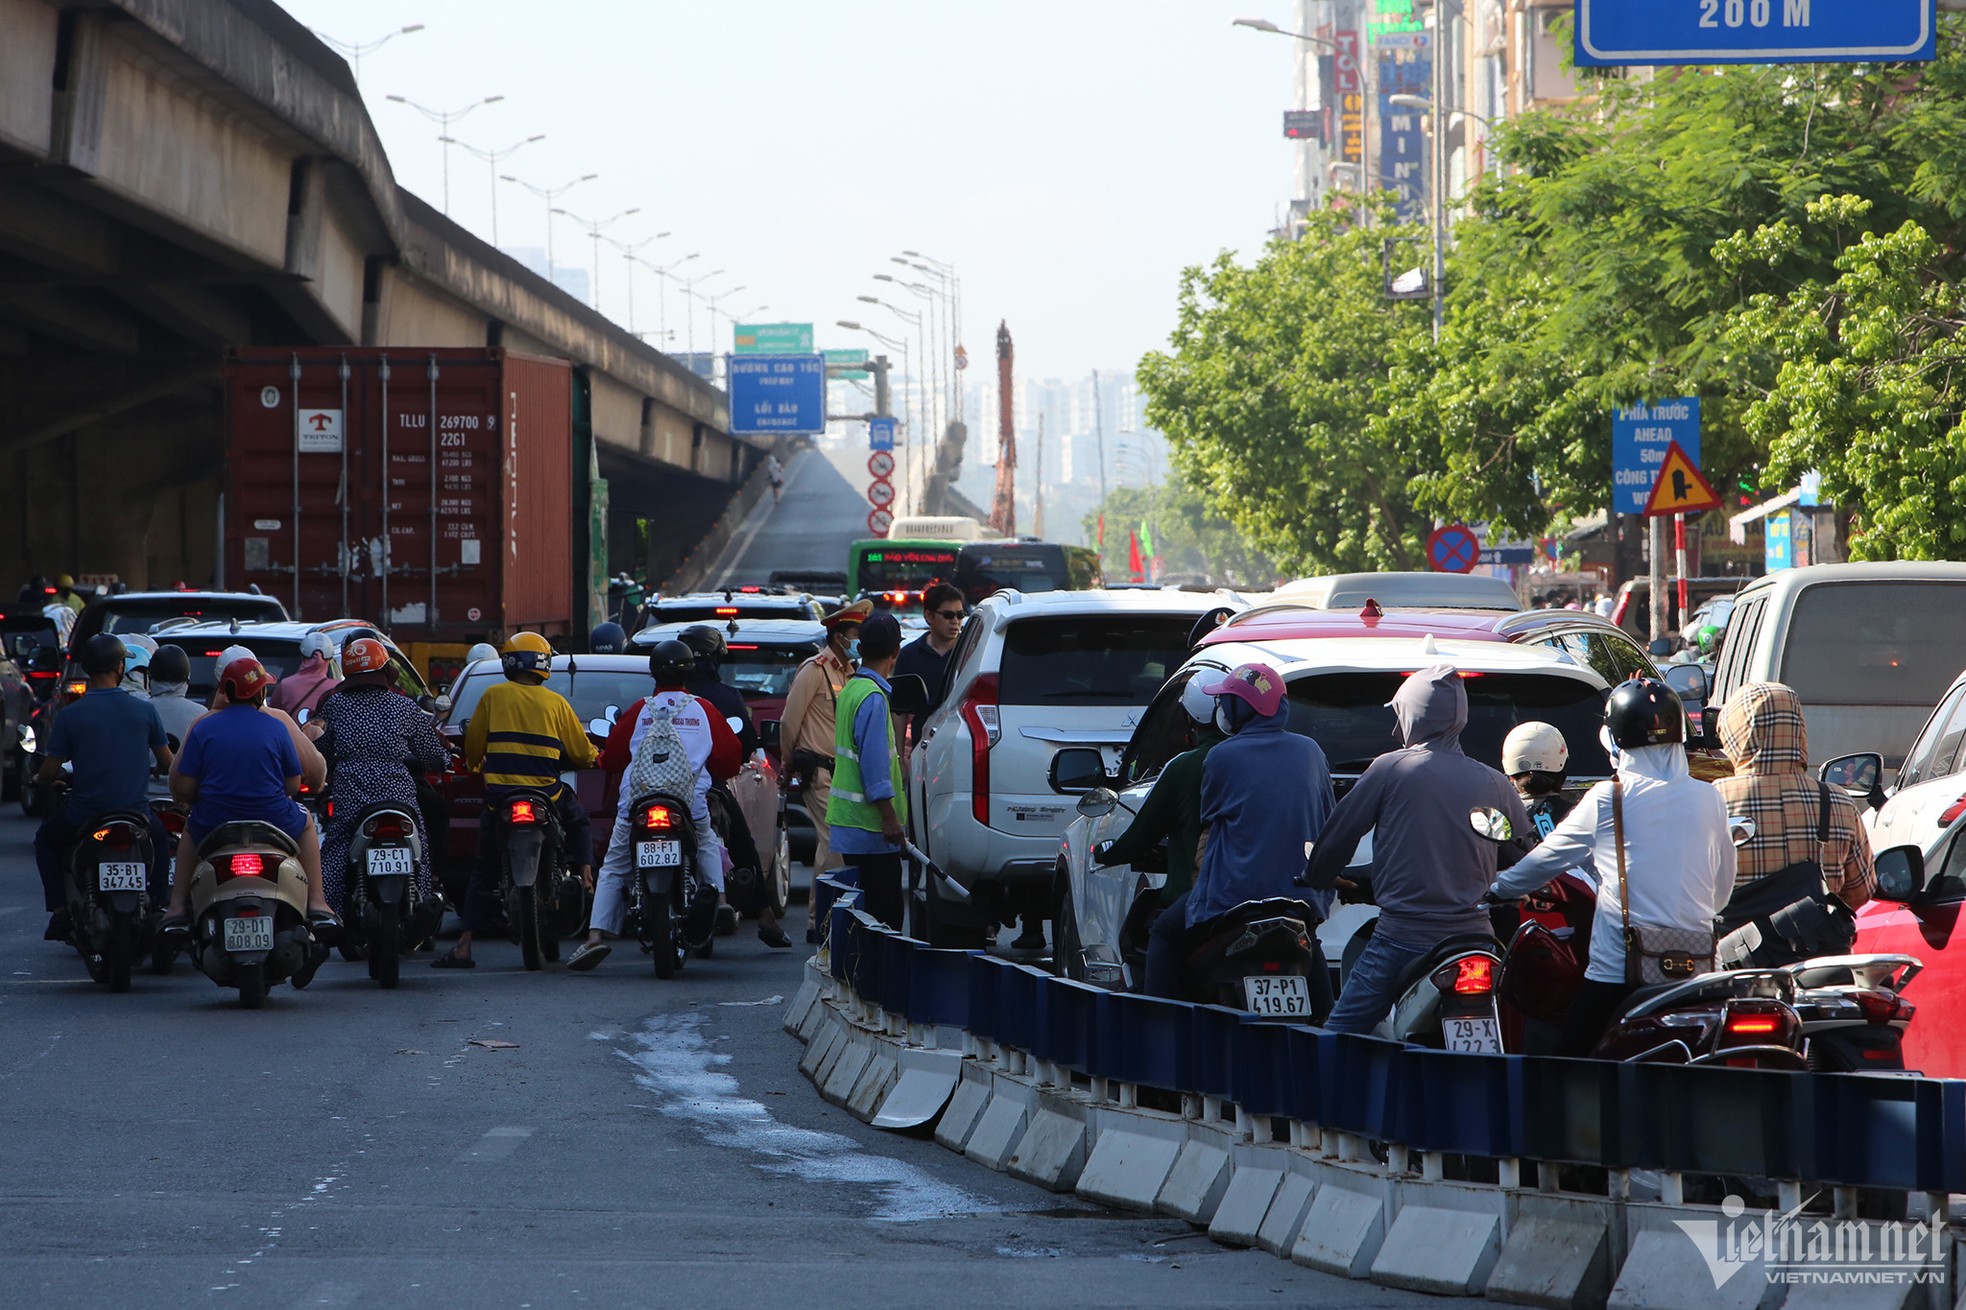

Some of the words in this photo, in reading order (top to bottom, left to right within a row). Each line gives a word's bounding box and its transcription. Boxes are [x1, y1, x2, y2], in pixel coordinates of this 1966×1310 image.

[1699, 0, 1770, 28] 200
[1783, 0, 1810, 27] M
[1652, 402, 1690, 420] TRƯỚC
[400, 414, 425, 428] TLLU
[440, 416, 479, 429] 269700
[487, 417, 496, 429] 9
[441, 433, 466, 446] 22G1
[1634, 427, 1673, 442] AHEAD
[1615, 468, 1647, 486] CÔNG
[373, 849, 404, 861] 29-C1
[644, 842, 674, 853] 88-F1
[640, 853, 678, 866] 602.82
[106, 864, 138, 876] 35-B1
[370, 861, 409, 874] 710.91
[102, 876, 143, 889] 347.45
[232, 919, 265, 934] 29-D1
[229, 934, 270, 949] 808.09
[1254, 979, 1298, 995] 37-P1
[1253, 996, 1305, 1014] 419.67
